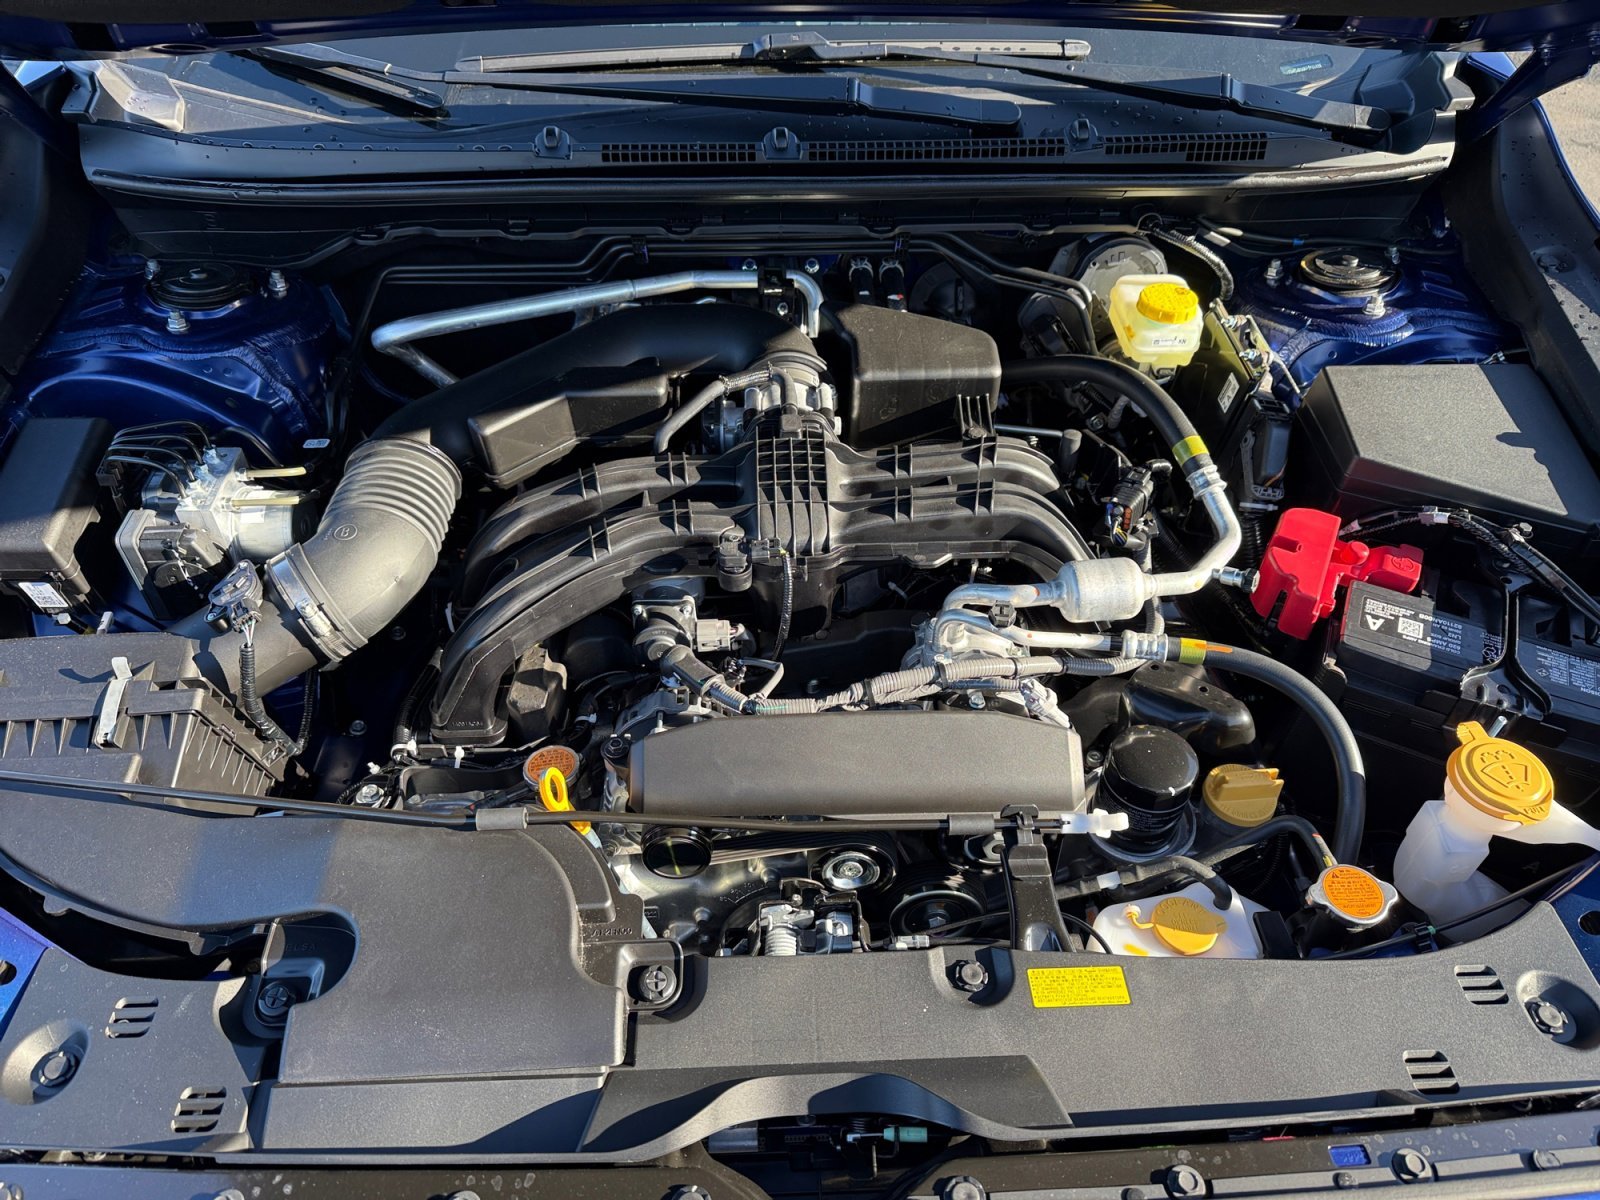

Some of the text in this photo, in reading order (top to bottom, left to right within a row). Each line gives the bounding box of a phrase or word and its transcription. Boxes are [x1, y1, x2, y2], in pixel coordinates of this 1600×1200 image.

[341, 526, 350, 537] B
[1365, 614, 1385, 631] A
[1418, 639, 1446, 651] CRANKING
[1427, 636, 1461, 651] 620 AMPS
[1446, 647, 1460, 655] COLD
